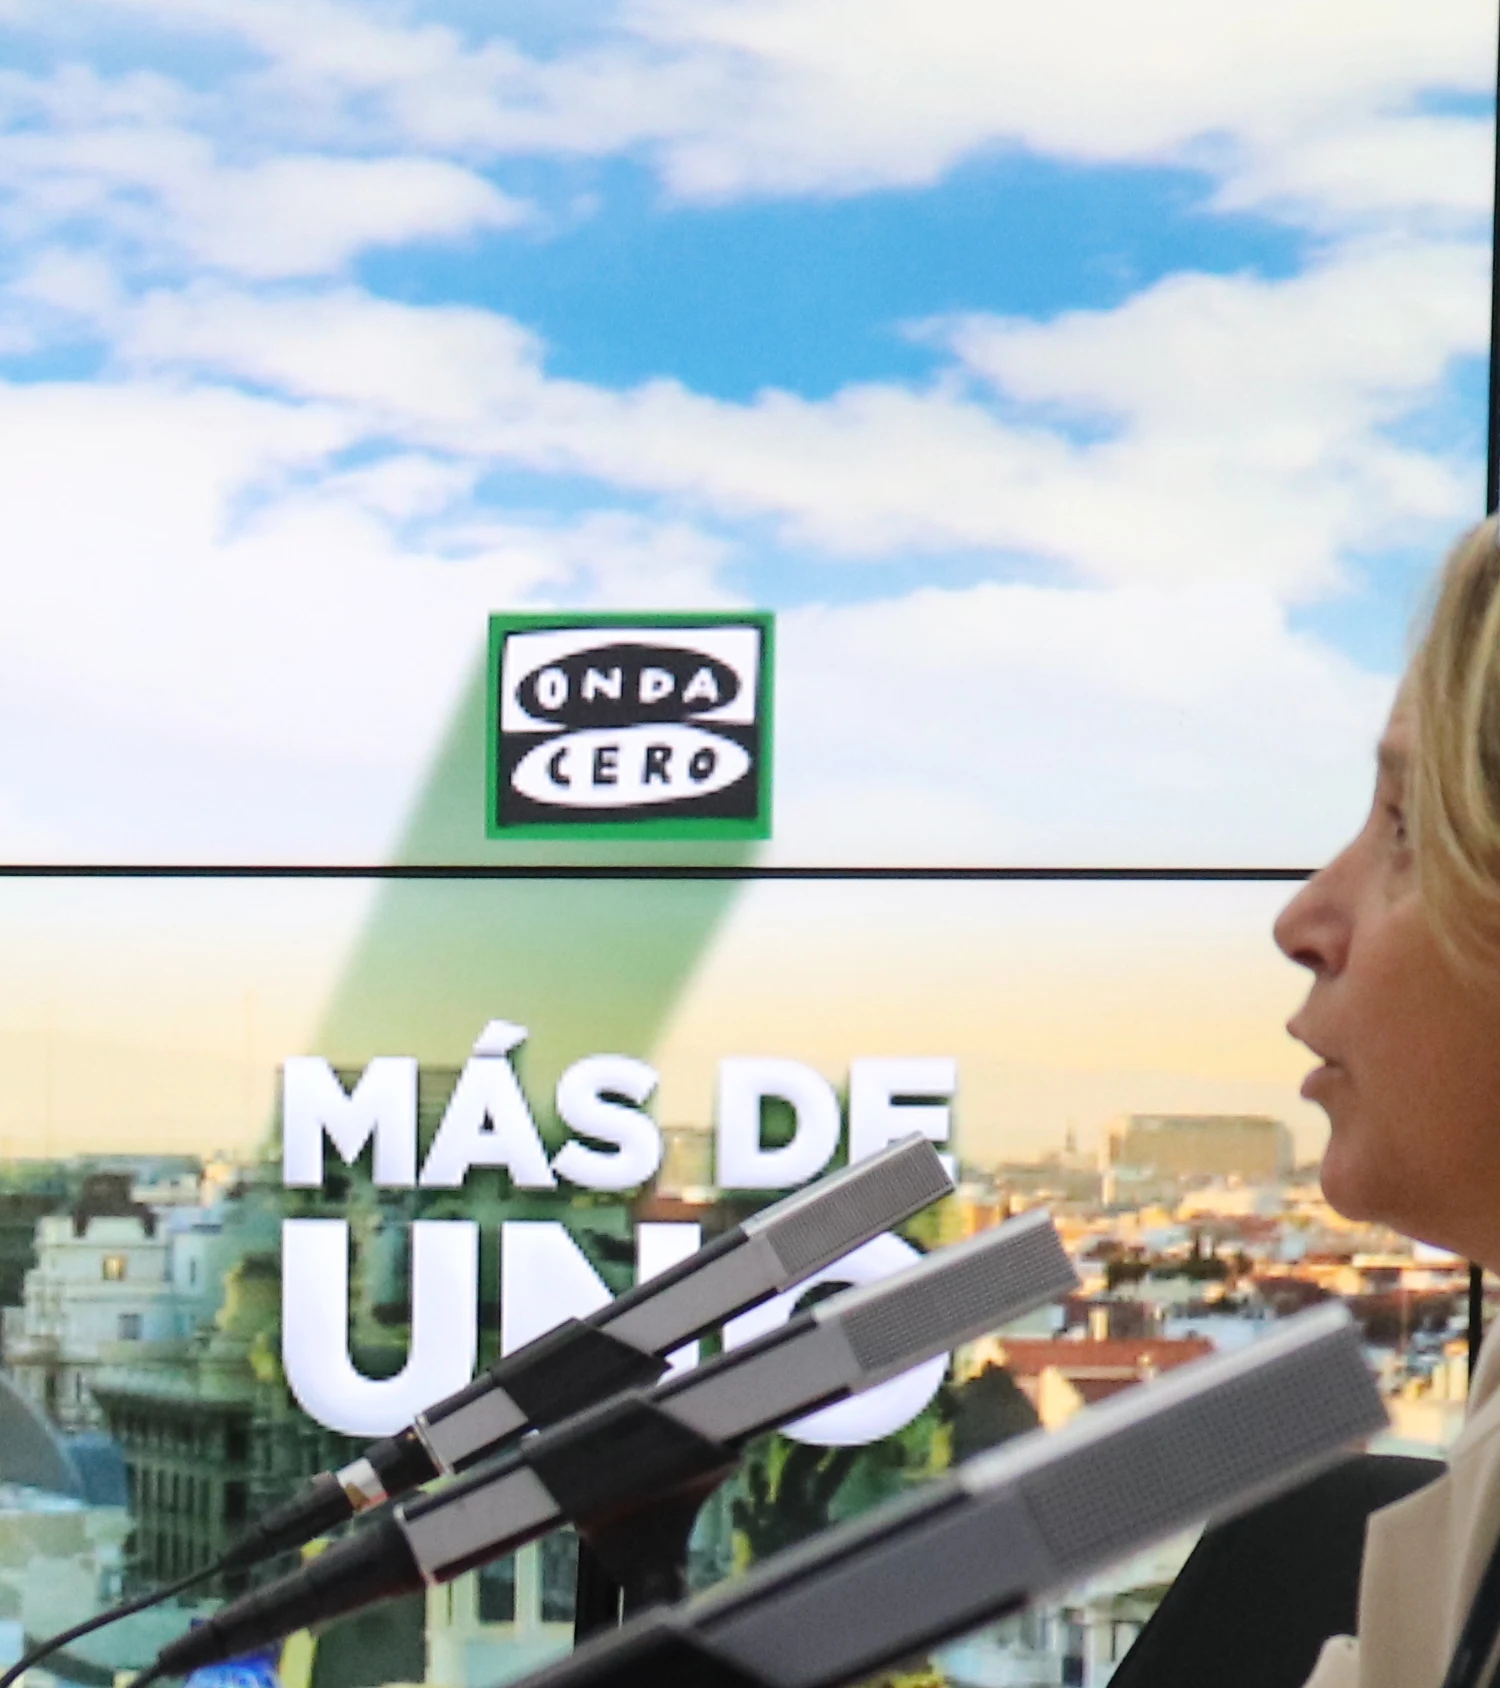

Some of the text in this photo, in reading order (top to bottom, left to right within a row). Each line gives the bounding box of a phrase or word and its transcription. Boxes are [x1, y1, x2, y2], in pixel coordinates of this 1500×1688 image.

[535, 666, 721, 710] ONDA
[546, 744, 718, 786] CERO
[282, 1020, 957, 1190] MÁS DE
